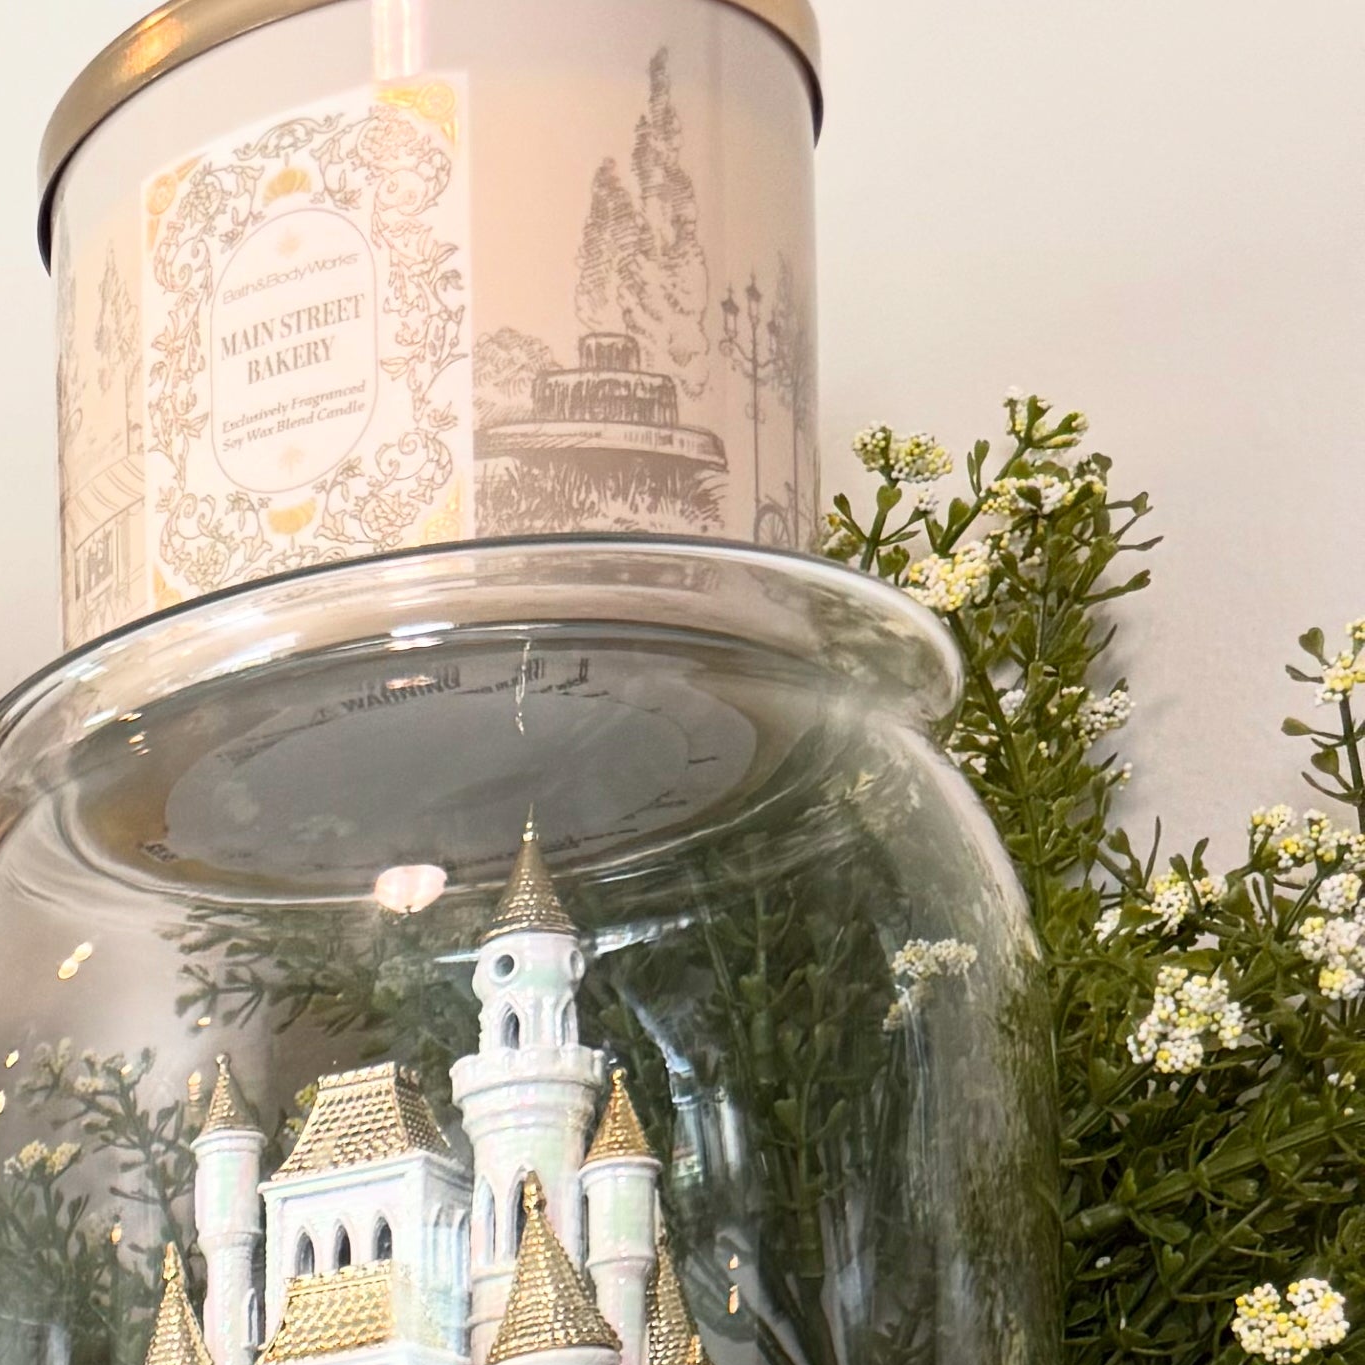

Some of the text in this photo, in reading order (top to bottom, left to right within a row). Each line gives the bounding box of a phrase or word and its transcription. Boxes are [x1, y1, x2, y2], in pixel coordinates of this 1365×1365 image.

[220, 293, 365, 361] MAIN STREET
[247, 335, 336, 385] BAKERY
[221, 379, 366, 434] Exclusively Fragranced
[221, 399, 366, 452] Soy Wax Blend Candle
